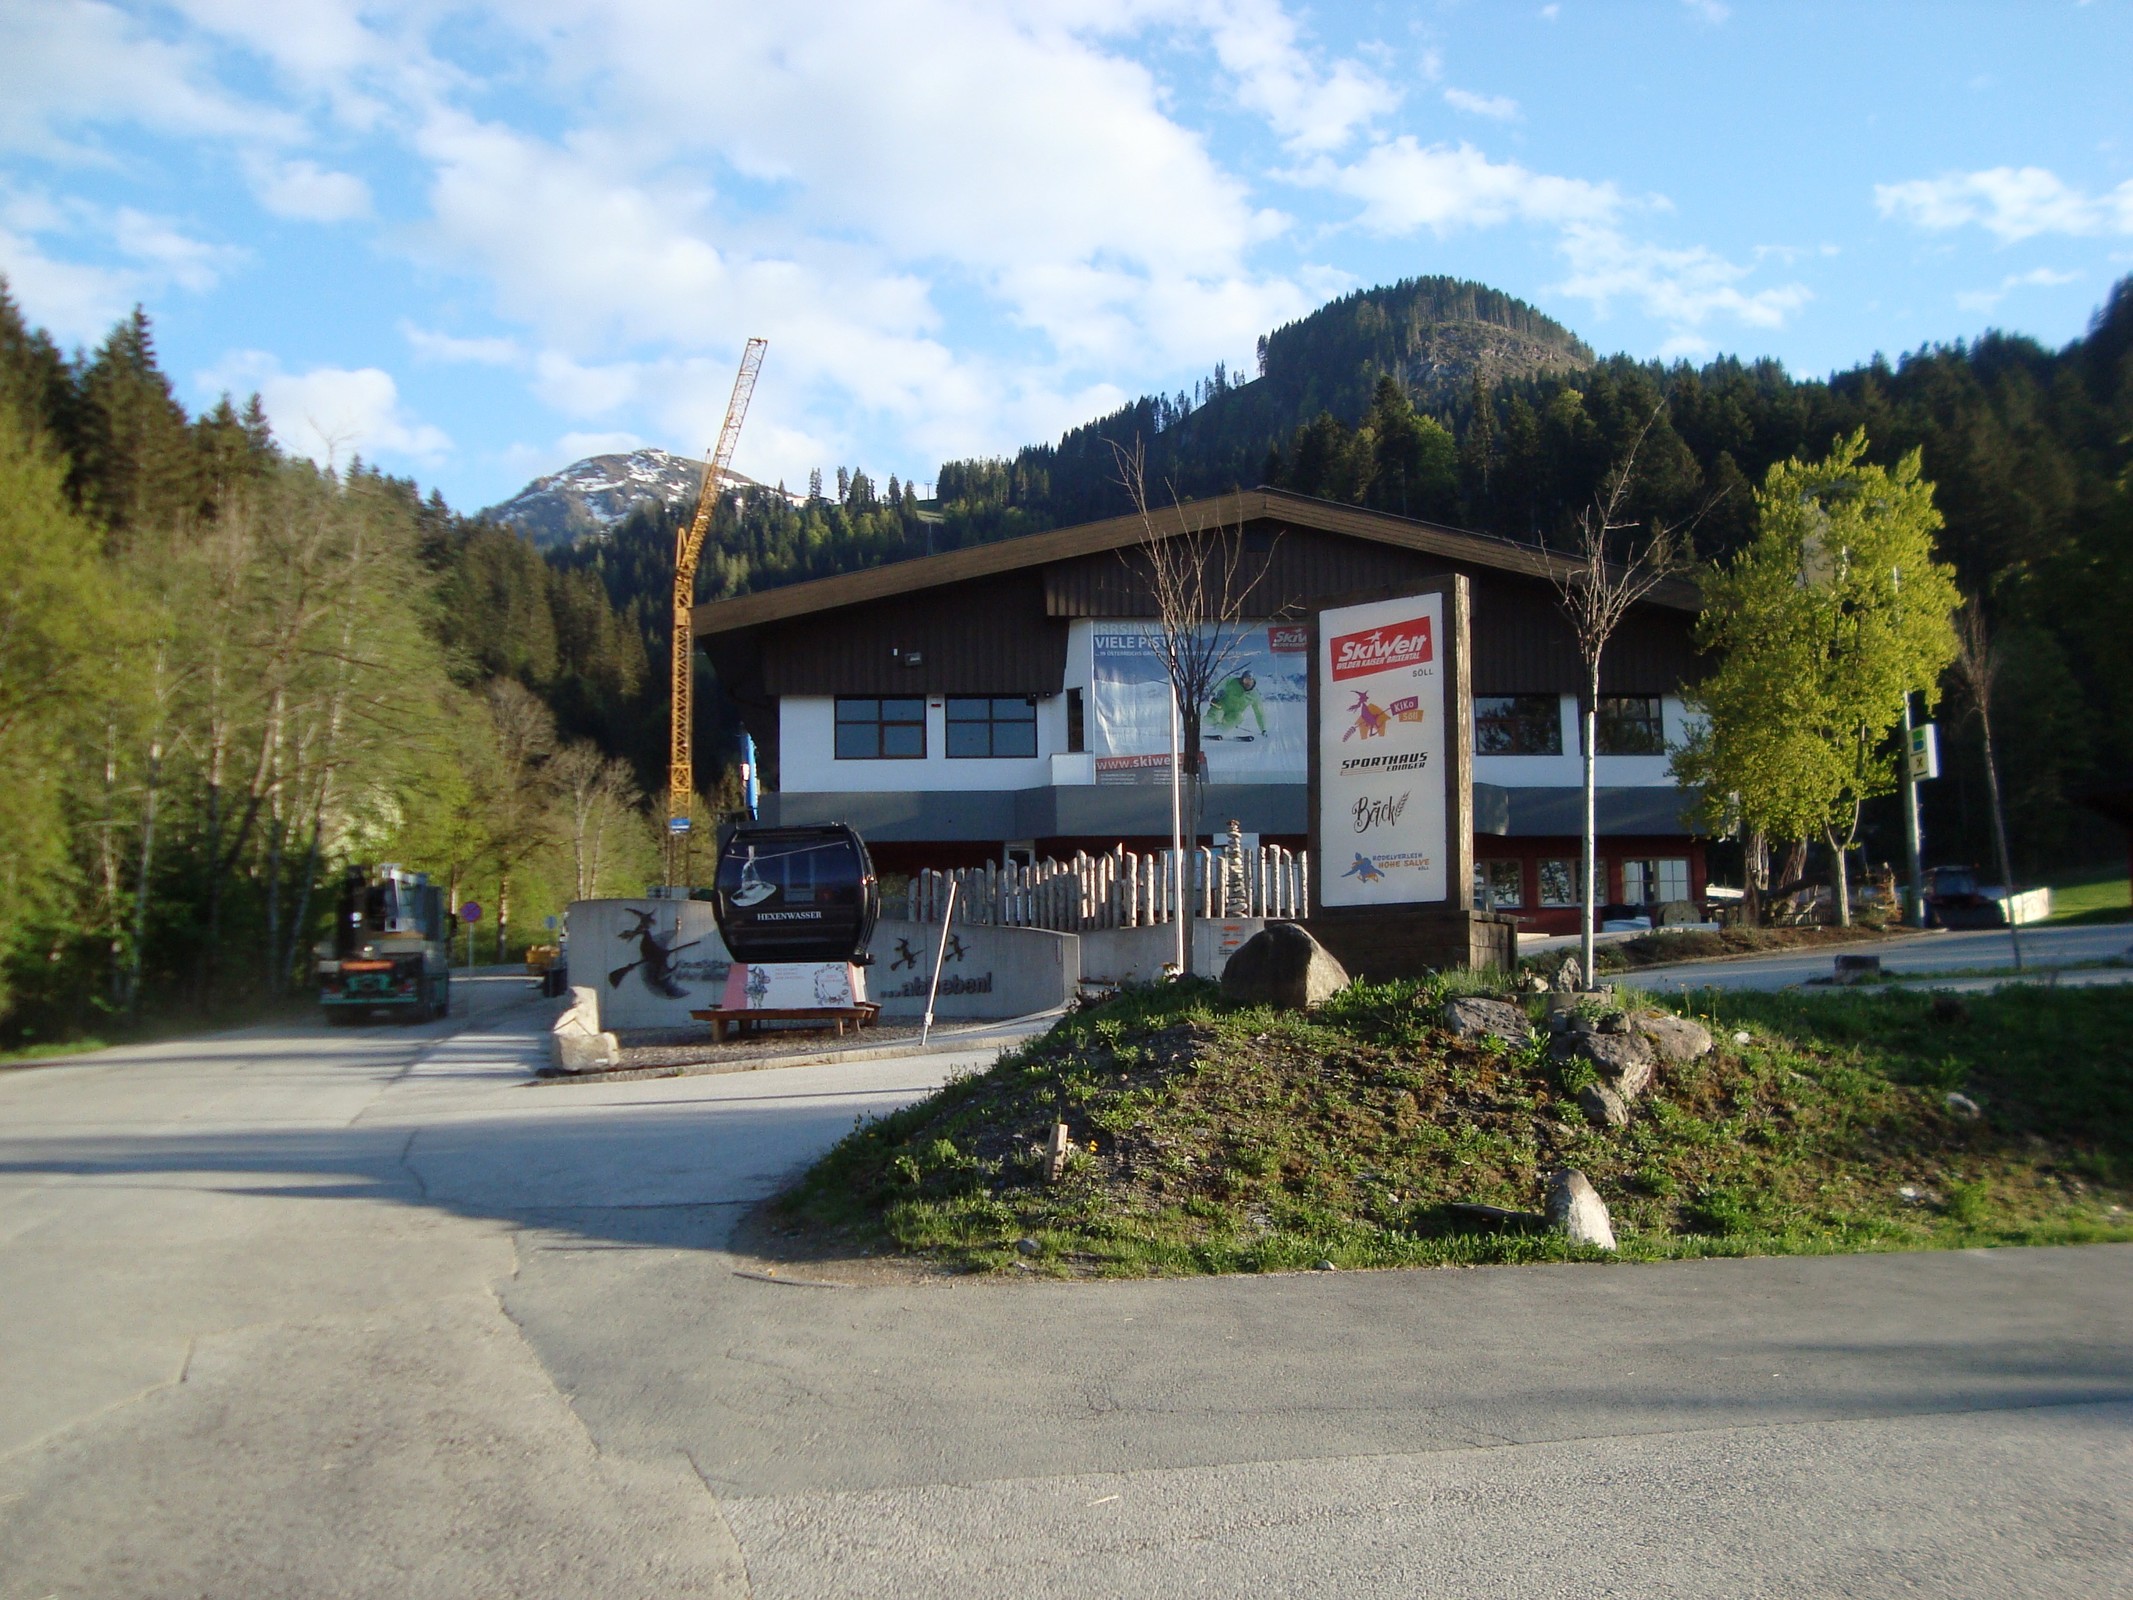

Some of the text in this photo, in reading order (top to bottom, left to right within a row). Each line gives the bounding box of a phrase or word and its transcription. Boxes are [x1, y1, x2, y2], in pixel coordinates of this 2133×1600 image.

[1095, 623, 1171, 635] IRRSINNI
[1095, 636, 1188, 649] VIELE PISTN
[1338, 634, 1427, 662] SkiWelt
[1341, 751, 1428, 769] SPORTHAUS
[1386, 762, 1425, 771] EDINGER
[1352, 796, 1395, 833] Bäck
[1378, 858, 1430, 869] HOHE SALVE
[757, 911, 822, 921] HEXENWASSER
